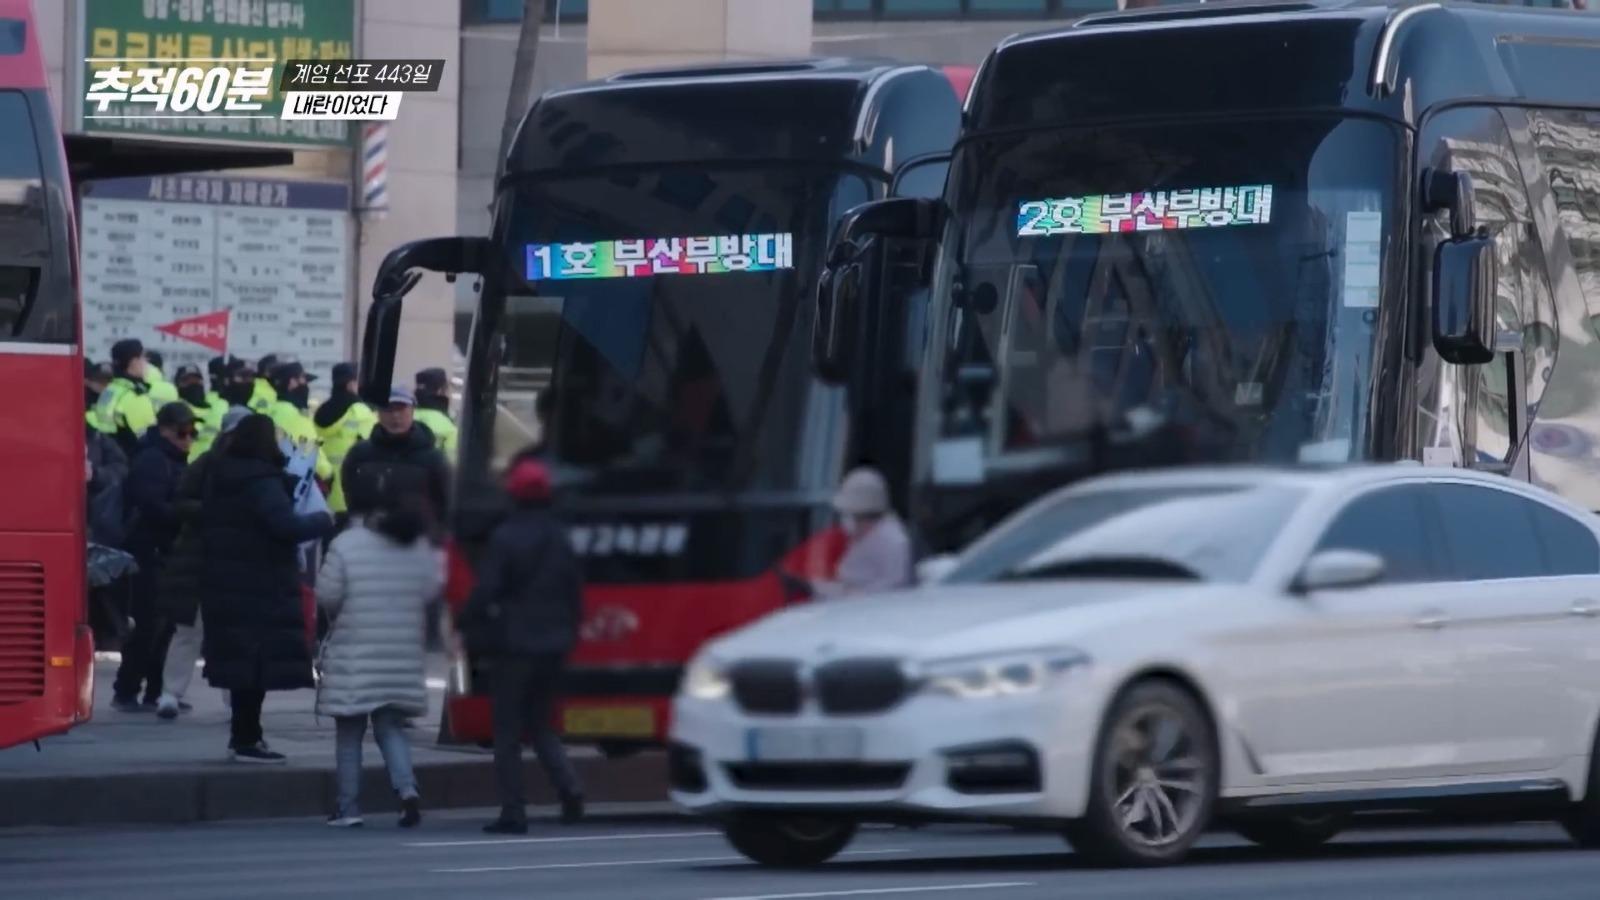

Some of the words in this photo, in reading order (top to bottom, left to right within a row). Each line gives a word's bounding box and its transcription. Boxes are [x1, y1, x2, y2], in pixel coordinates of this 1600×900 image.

[1018, 197, 1084, 237] 2호
[1101, 184, 1274, 233] 부산부방대
[534, 241, 601, 278] 1호
[613, 232, 793, 277] 부산부방대
